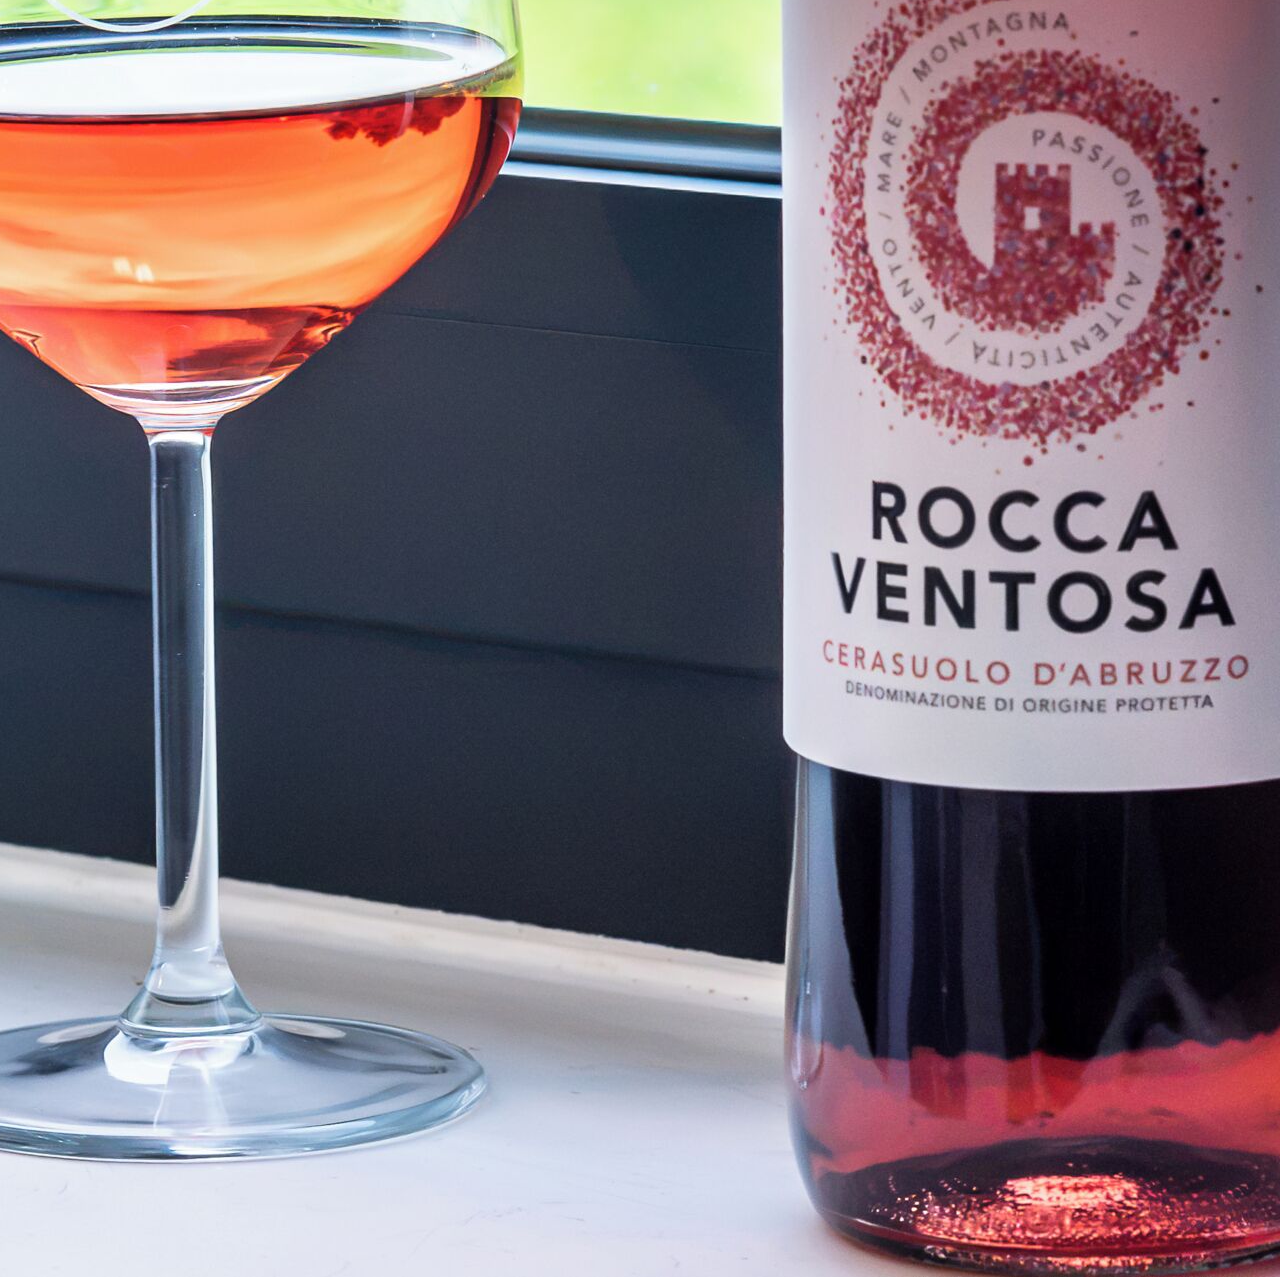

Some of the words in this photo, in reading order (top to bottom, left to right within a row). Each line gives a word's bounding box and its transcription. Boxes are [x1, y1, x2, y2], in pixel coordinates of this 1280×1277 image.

[912, 11, 1069, 82] MONTAGNA
[877, 112, 903, 193] MARE
[1032, 129, 1150, 228] PASSIONE
[882, 238, 936, 330] VENTO
[871, 479, 1179, 554] ROCCA
[830, 551, 1237, 634] VENTOSA
[823, 639, 1011, 685] CERASUOLO
[1033, 654, 1250, 687] D'ABRUZZO
[845, 680, 986, 711] DENOMINAZIONE
[994, 697, 1014, 712] DI
[1022, 698, 1107, 713] ORIGINE
[1116, 694, 1214, 712] PROTETTA
